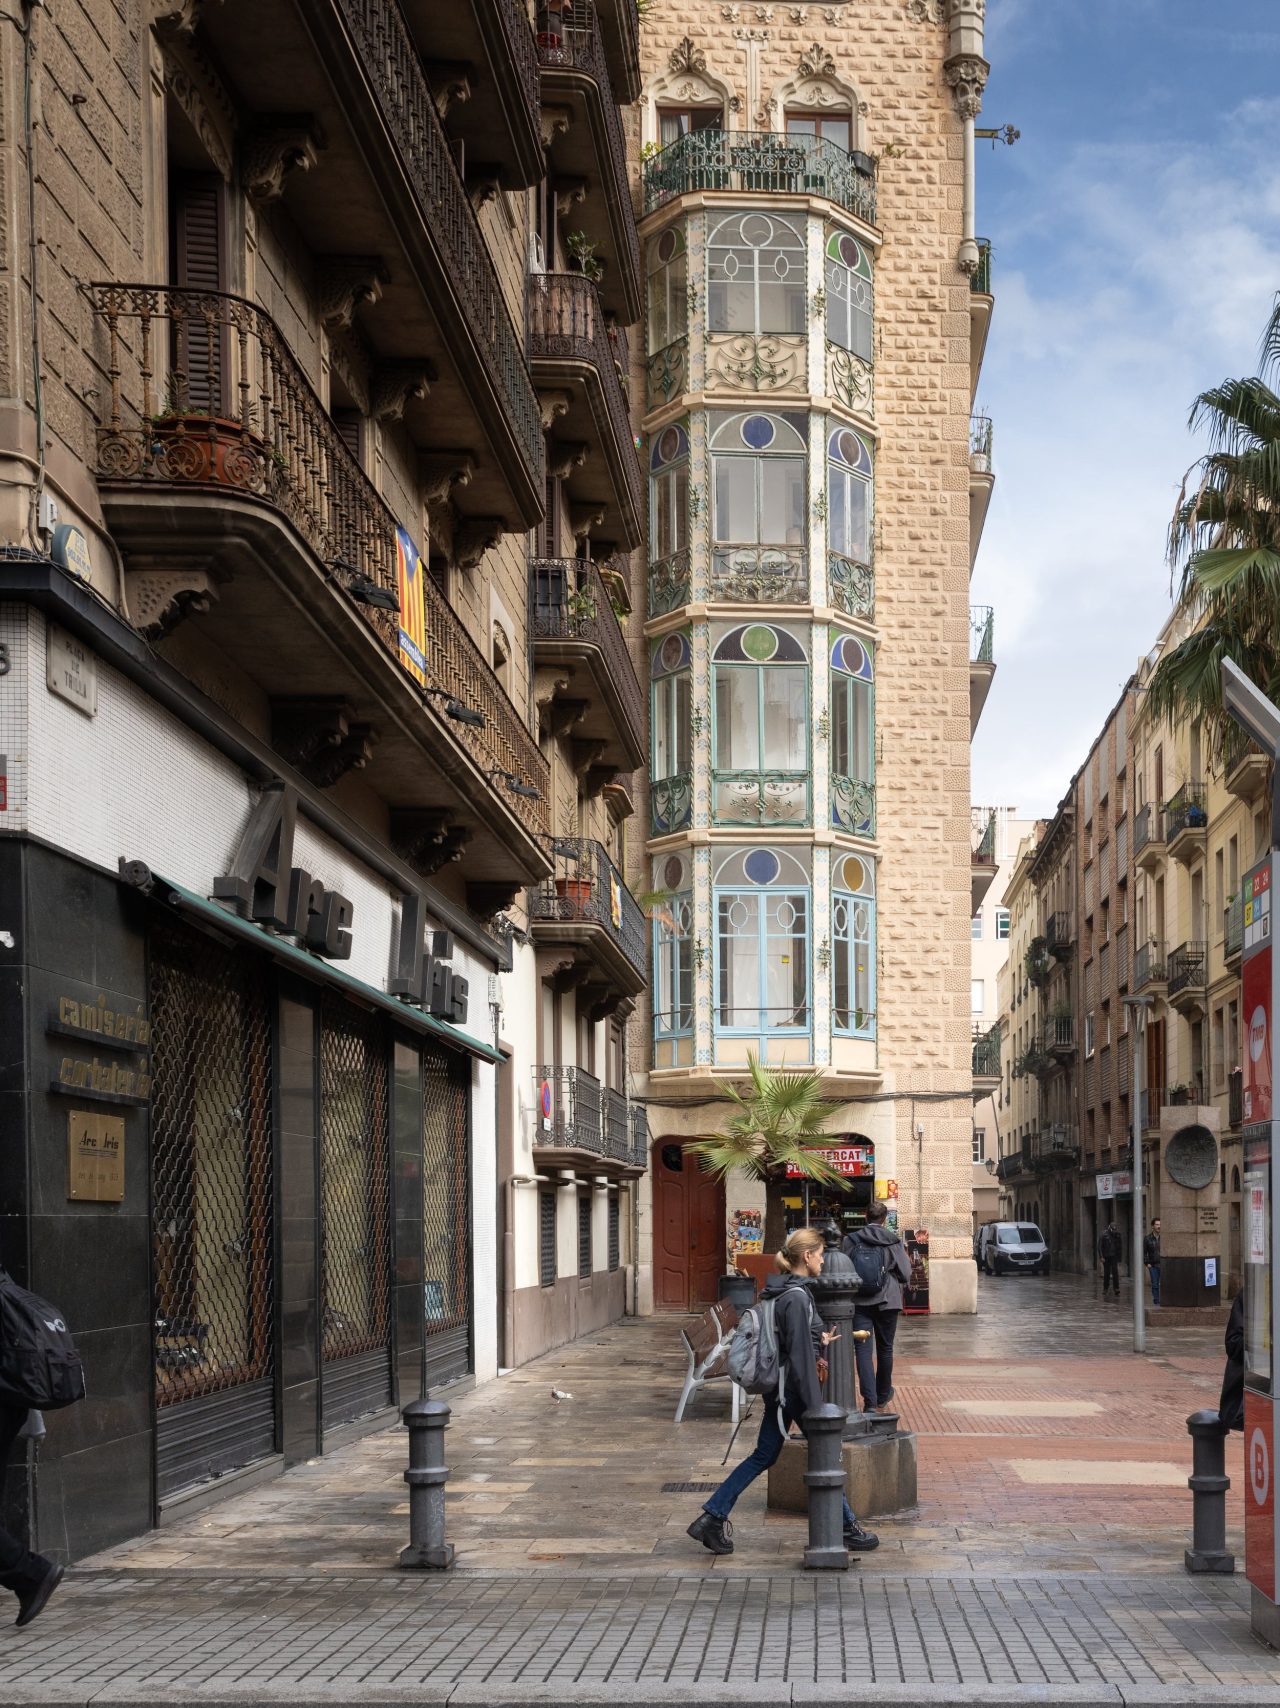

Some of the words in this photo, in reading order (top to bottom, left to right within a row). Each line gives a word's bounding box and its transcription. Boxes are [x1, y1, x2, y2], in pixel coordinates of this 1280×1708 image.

[213, 780, 354, 960] Arc
[391, 894, 469, 1025] Iris
[1252, 1024, 1265, 1042] TMB
[80, 1130, 97, 1147] Arc
[104, 1132, 119, 1150] Iris
[1254, 1442, 1265, 1489] B
